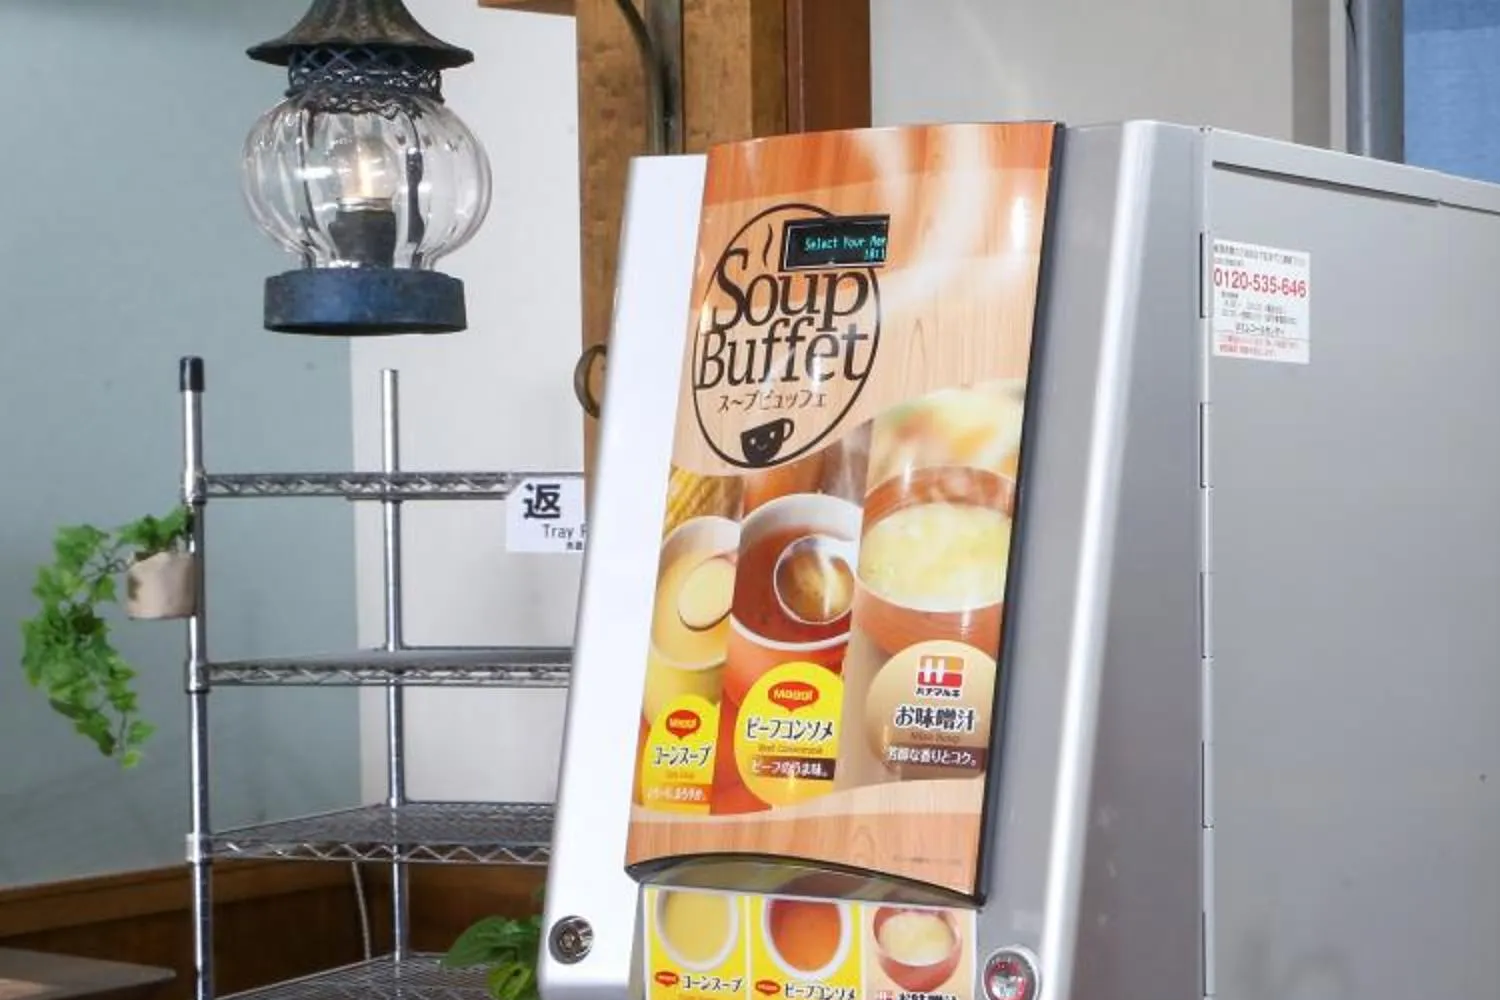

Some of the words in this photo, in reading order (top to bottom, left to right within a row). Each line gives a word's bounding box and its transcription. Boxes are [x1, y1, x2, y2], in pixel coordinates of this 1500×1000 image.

[804, 235, 837, 250] Select
[711, 246, 869, 332] Soup
[695, 316, 869, 390] Buffet
[522, 483, 561, 519] 返
[542, 523, 574, 540] Tray
[747, 717, 833, 741] ビーフコンソメ
[895, 705, 974, 731] お味噌汁
[654, 745, 712, 766] コーンスープ
[683, 975, 743, 992] コーンスープ
